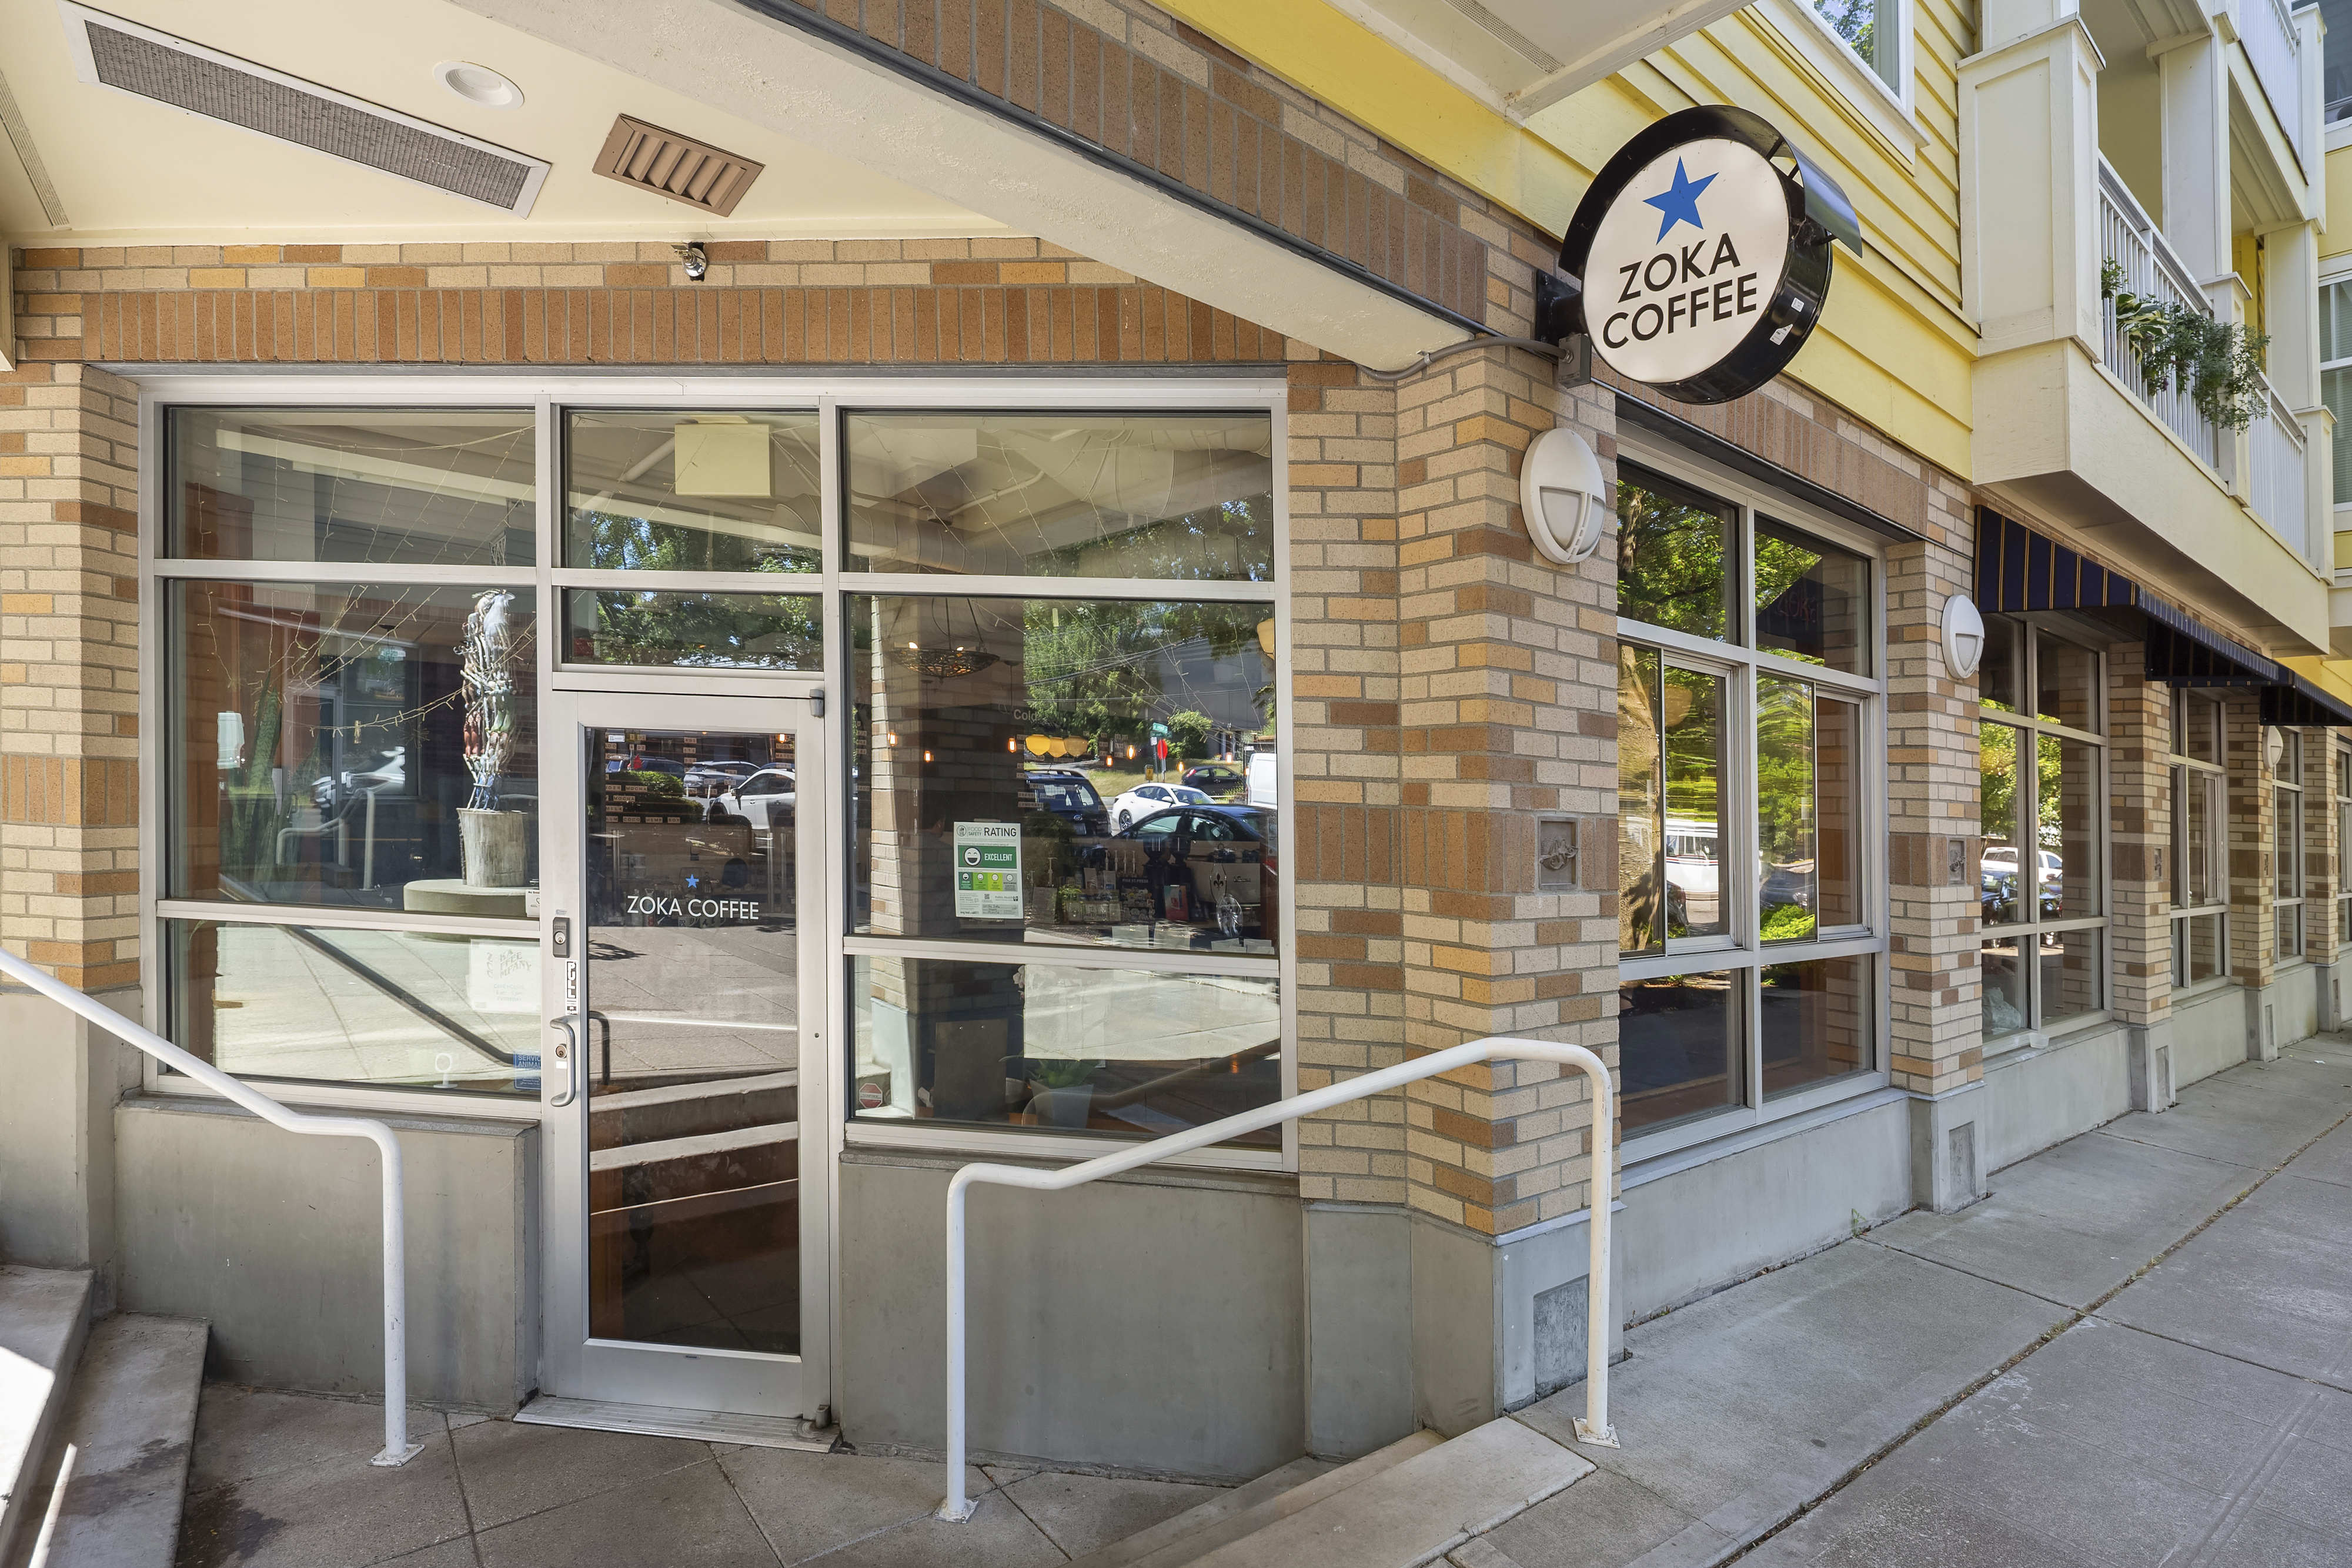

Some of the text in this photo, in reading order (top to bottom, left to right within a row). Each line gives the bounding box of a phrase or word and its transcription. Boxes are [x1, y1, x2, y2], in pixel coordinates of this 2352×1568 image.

[1617, 232, 1741, 304] ZOKA
[1602, 271, 1758, 349] COFFEE
[1013, 709, 1037, 721] Cold
[984, 827, 1017, 837] RATING
[984, 853, 1013, 862] EXCELLENT
[627, 895, 759, 920] ZOKA COFFEE
[567, 962, 576, 998] PULL
